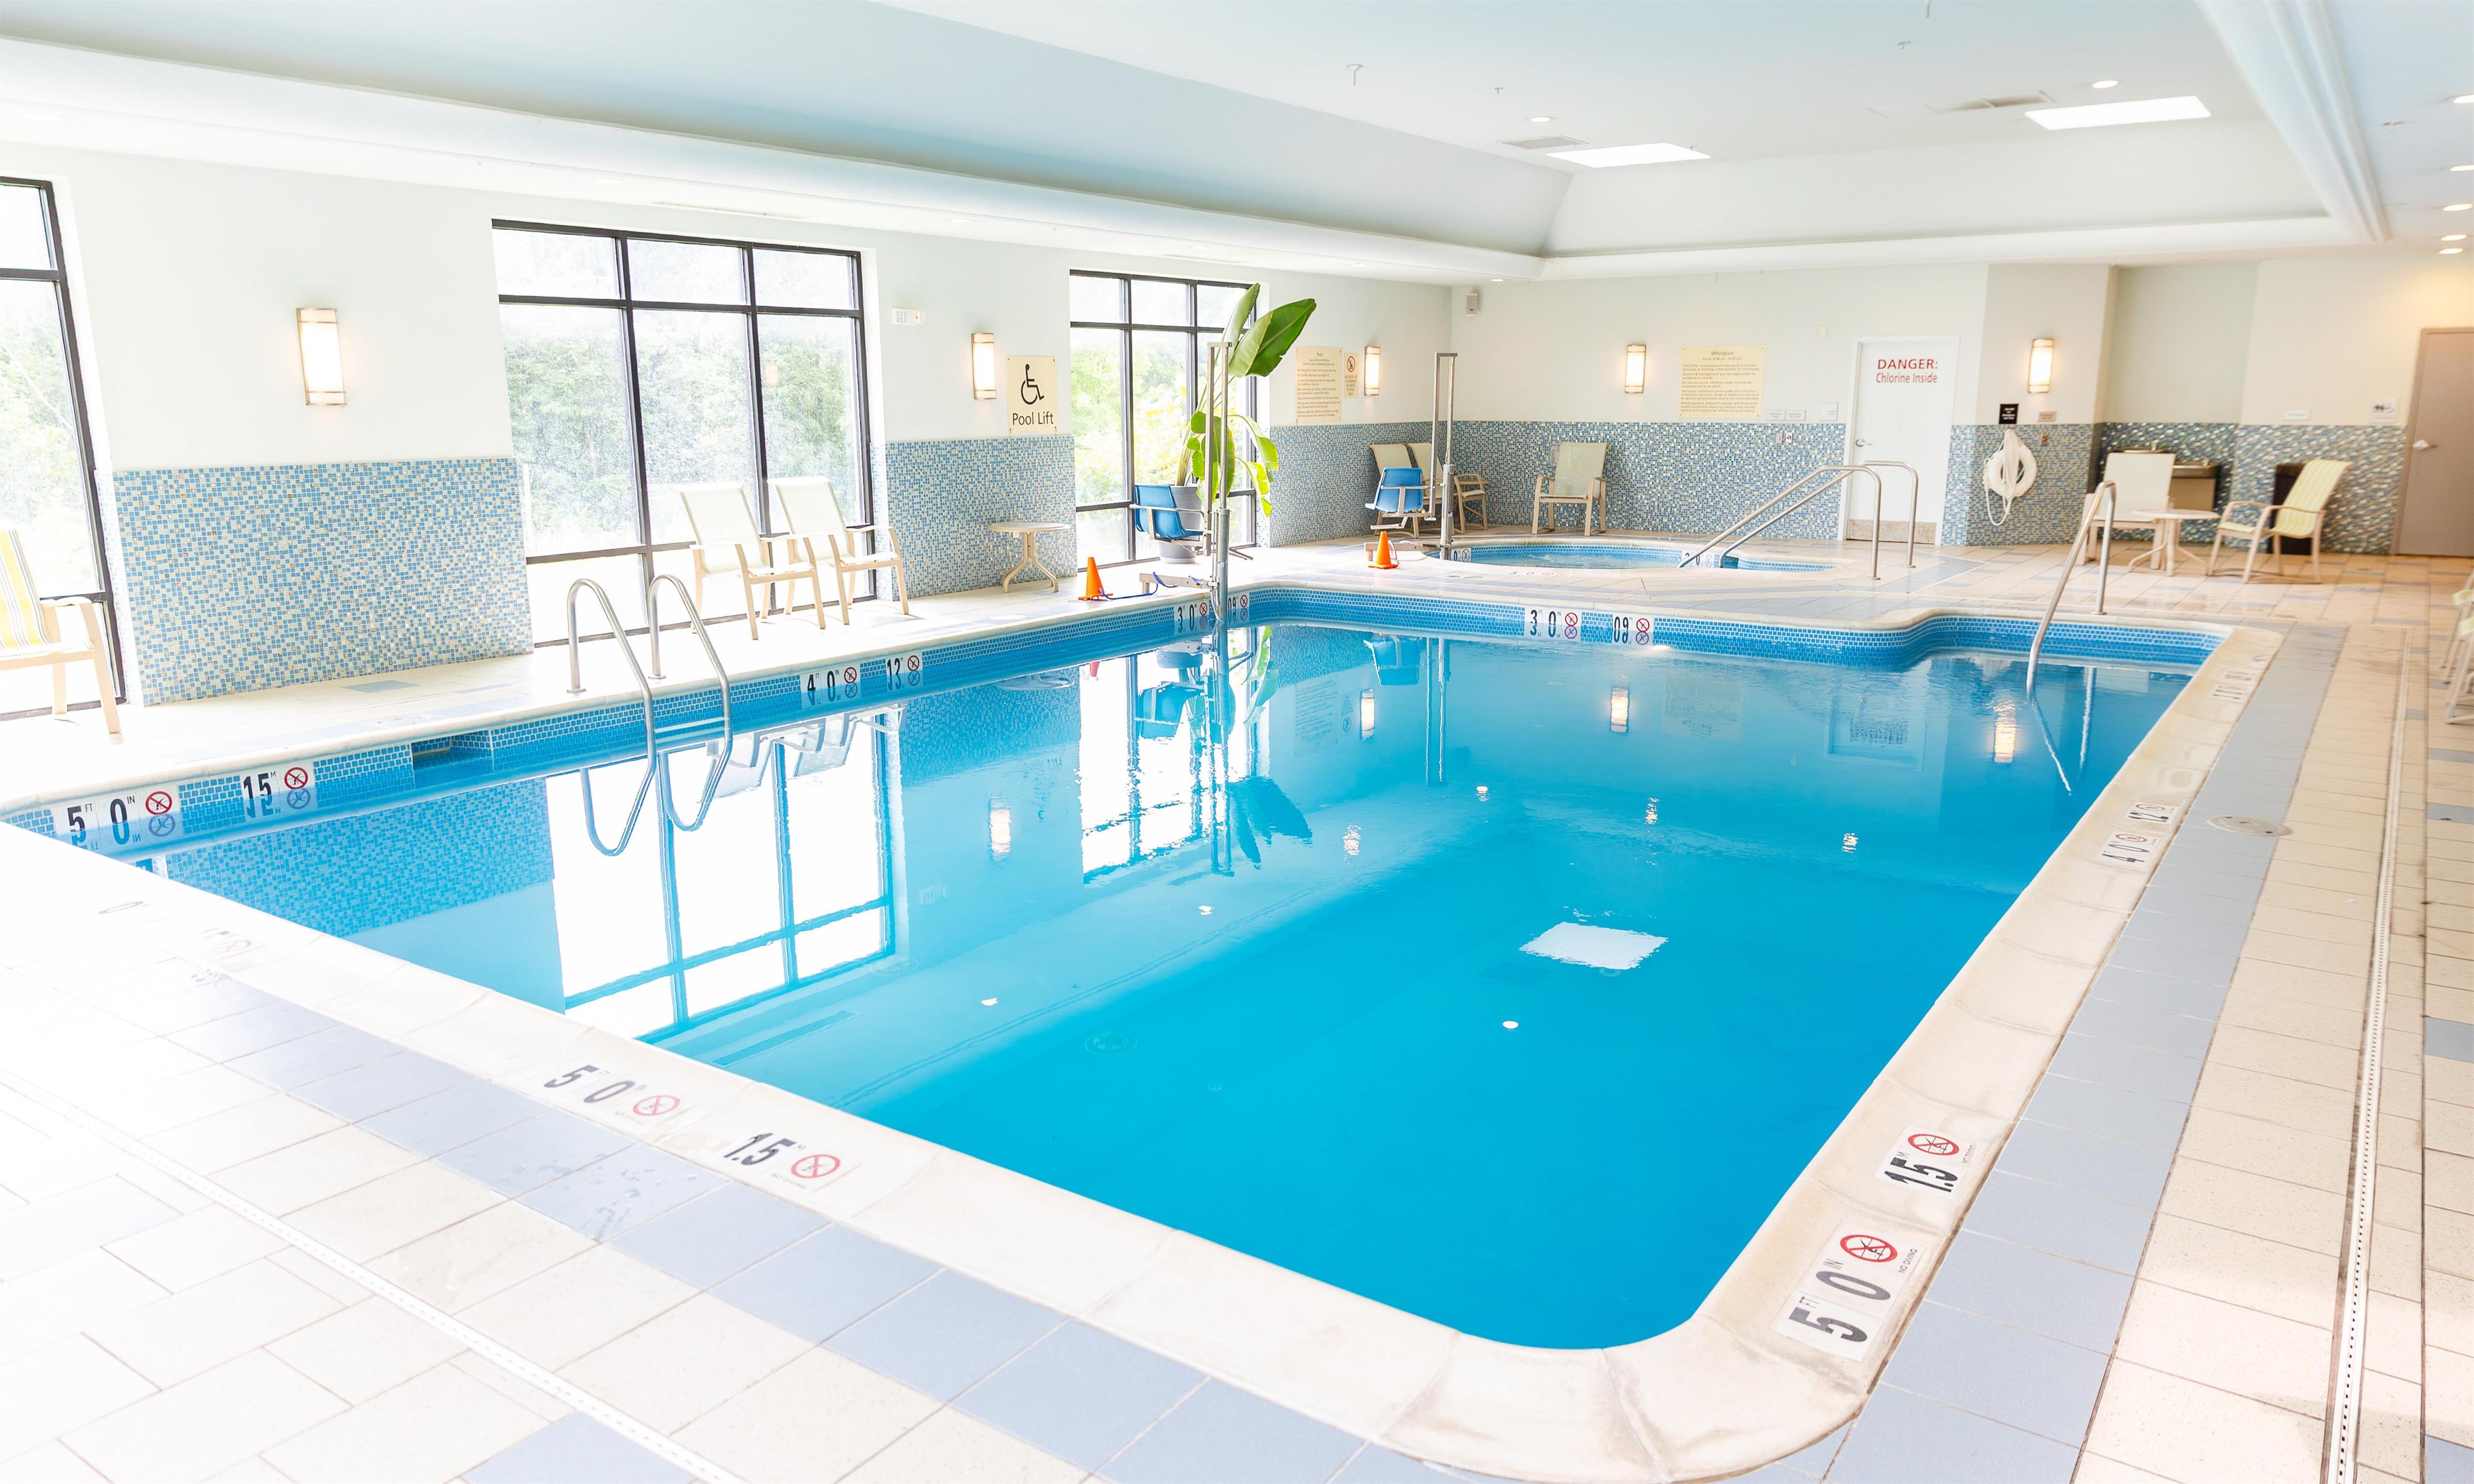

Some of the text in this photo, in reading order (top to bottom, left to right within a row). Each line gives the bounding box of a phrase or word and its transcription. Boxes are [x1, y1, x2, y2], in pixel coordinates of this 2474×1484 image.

[1878, 359, 1937, 369] DANGER:
[1876, 372, 1937, 383] Chlorine Inside
[1013, 412, 1054, 425] Pool Lift
[1178, 606, 1183, 621] 3
[1189, 604, 1194, 618] 0
[1530, 610, 1537, 624] 3
[1549, 611, 1556, 625] 0
[807, 674, 816, 692] 4
[827, 671, 835, 688] 0
[67, 796, 135, 833] 5 FT 0 IN
[544, 1065, 600, 1088] 5
[583, 1080, 636, 1103] 0
[723, 1133, 797, 1166] 1.5
[1884, 1157, 1958, 1193] 1.5
[1823, 1258, 1844, 1270] IN
[1898, 1249, 1917, 1274] NO DIVING
[1816, 1271, 1891, 1301] 0
[1788, 1307, 1868, 1342] 5
